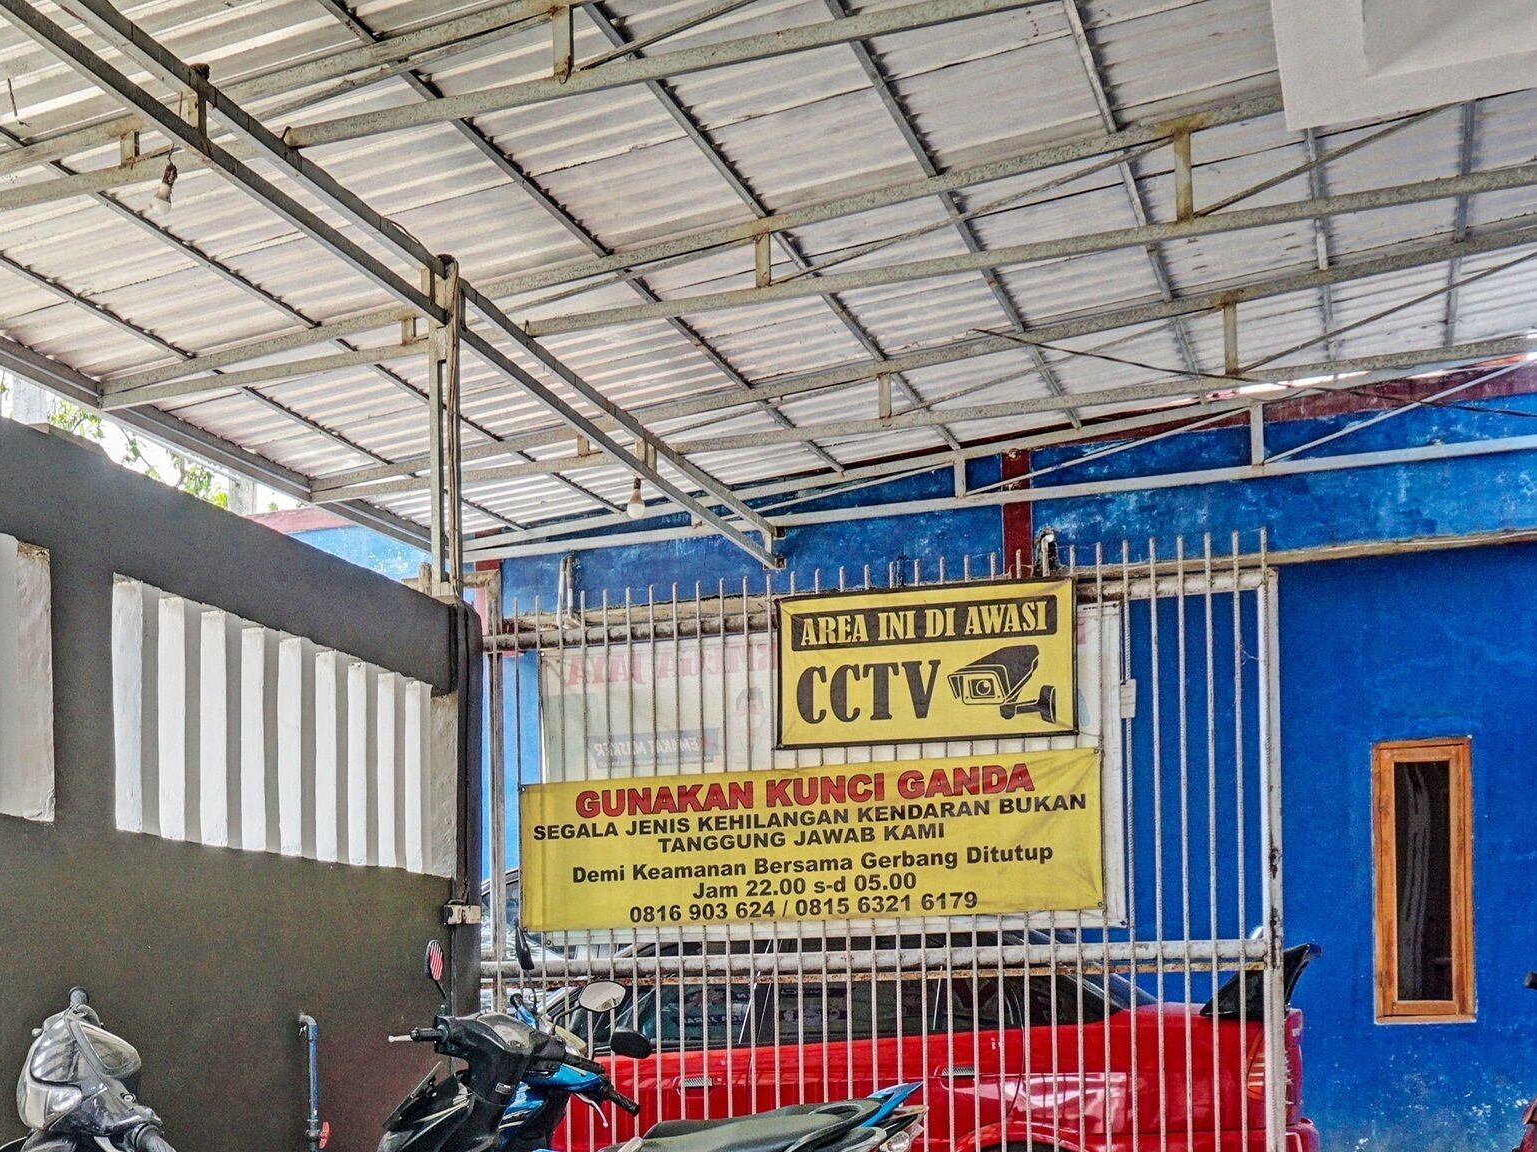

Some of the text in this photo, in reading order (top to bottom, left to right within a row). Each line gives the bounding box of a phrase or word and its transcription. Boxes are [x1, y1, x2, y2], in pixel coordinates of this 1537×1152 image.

[800, 613, 869, 646] AREA
[878, 610, 916, 641] INI
[924, 607, 957, 638] DI
[964, 600, 1049, 635] AWASI
[796, 659, 941, 724] CCTV
[575, 762, 1036, 819] GUNAKAN KUNCI GANDA
[533, 793, 1086, 841] SEGALA JENIS KEHILANGAN KENDARAN BUKAN
[658, 822, 945, 853] TANGGUNG JAWAB KAMI
[572, 843, 1053, 884] Demi Keamanan Bersama Gerbang Ditutup
[629, 890, 978, 923] 0816 903 624 / 0815 6321 6179
[692, 872, 917, 900] Jam 22.00 s-d 05.00
